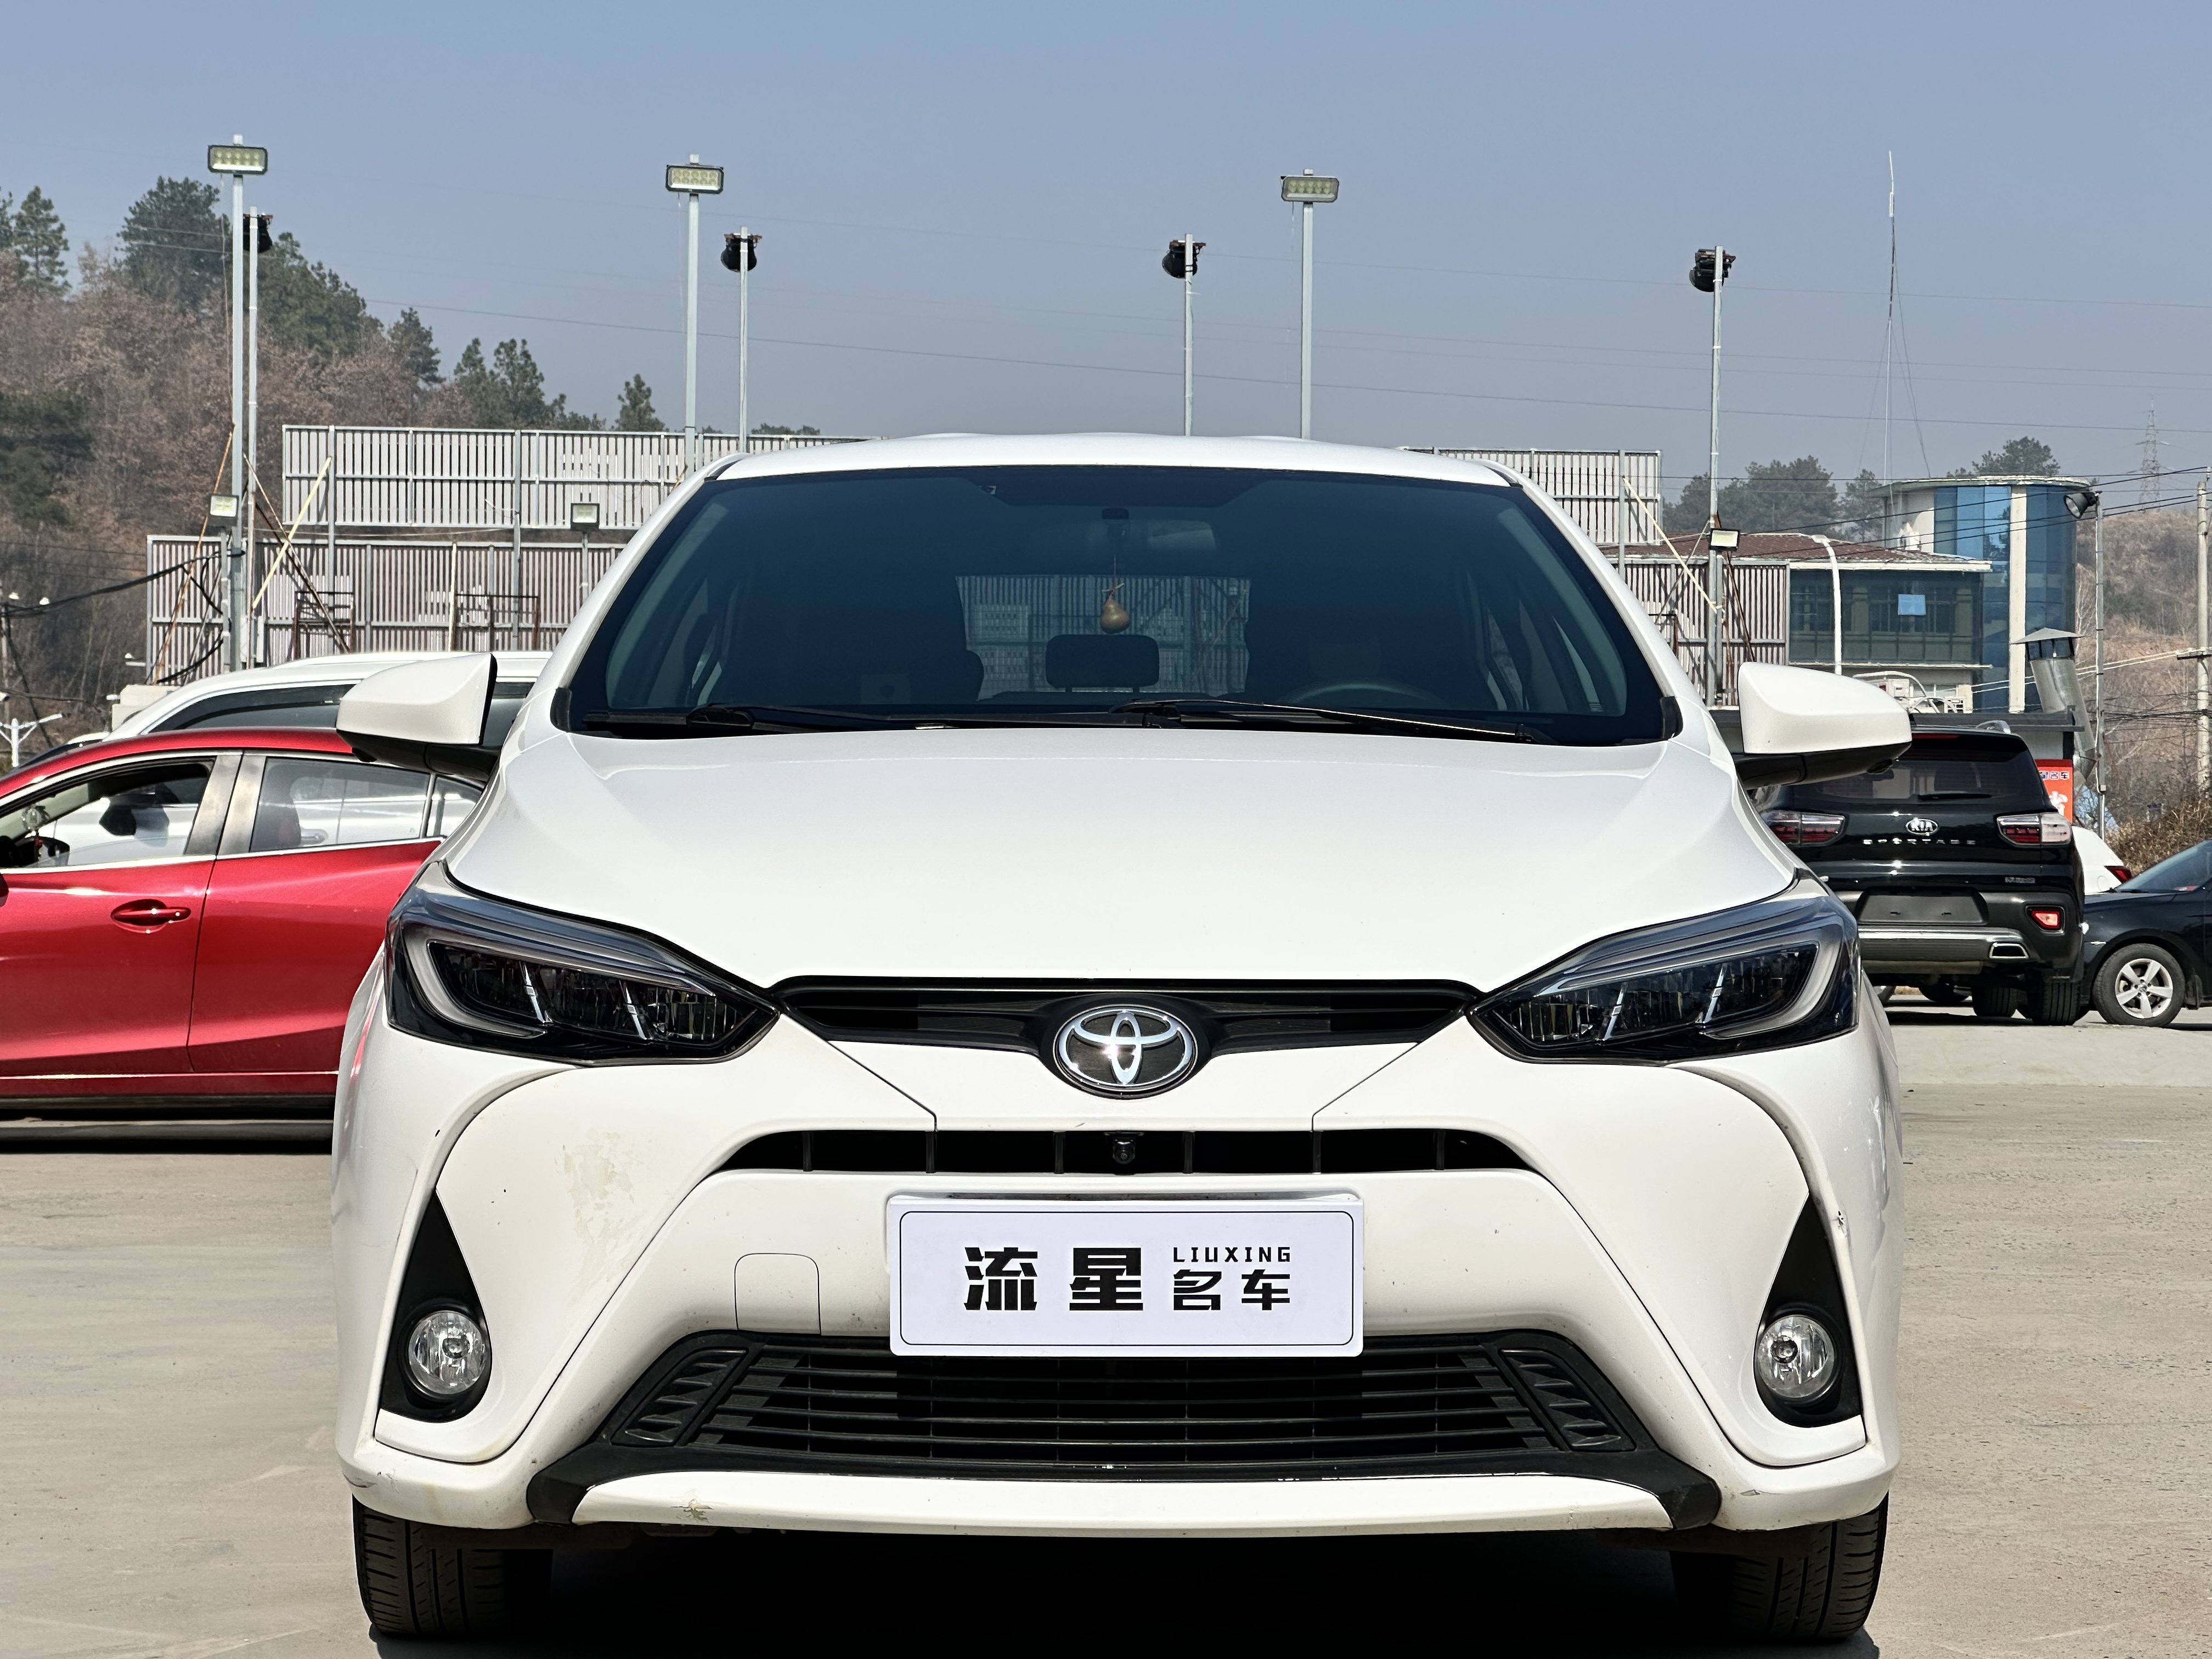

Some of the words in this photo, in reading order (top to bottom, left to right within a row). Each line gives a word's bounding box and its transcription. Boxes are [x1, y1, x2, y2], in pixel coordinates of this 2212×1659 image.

[1910, 821, 1933, 831] KIA
[1173, 1246, 1290, 1262] LIUXING
[964, 1247, 1143, 1311] 流星
[1173, 1269, 1290, 1311] 名车
